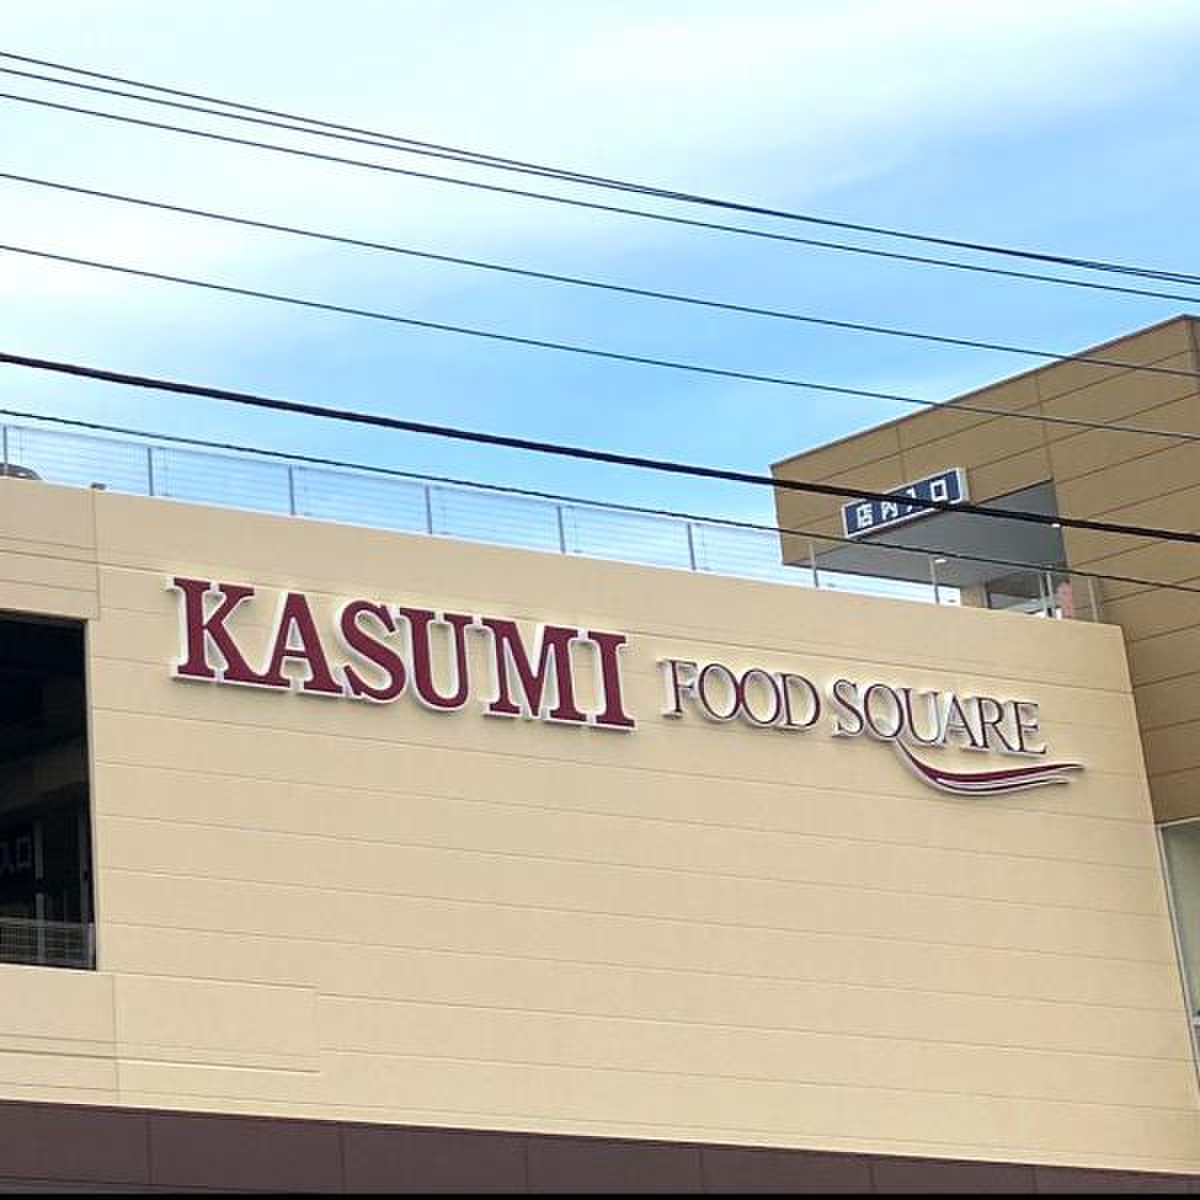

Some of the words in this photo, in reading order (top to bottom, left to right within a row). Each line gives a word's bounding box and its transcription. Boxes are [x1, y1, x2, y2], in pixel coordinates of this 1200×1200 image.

[172, 577, 636, 728] KASUMI
[662, 659, 821, 730] FOOD
[831, 678, 1084, 795] SQUARE
